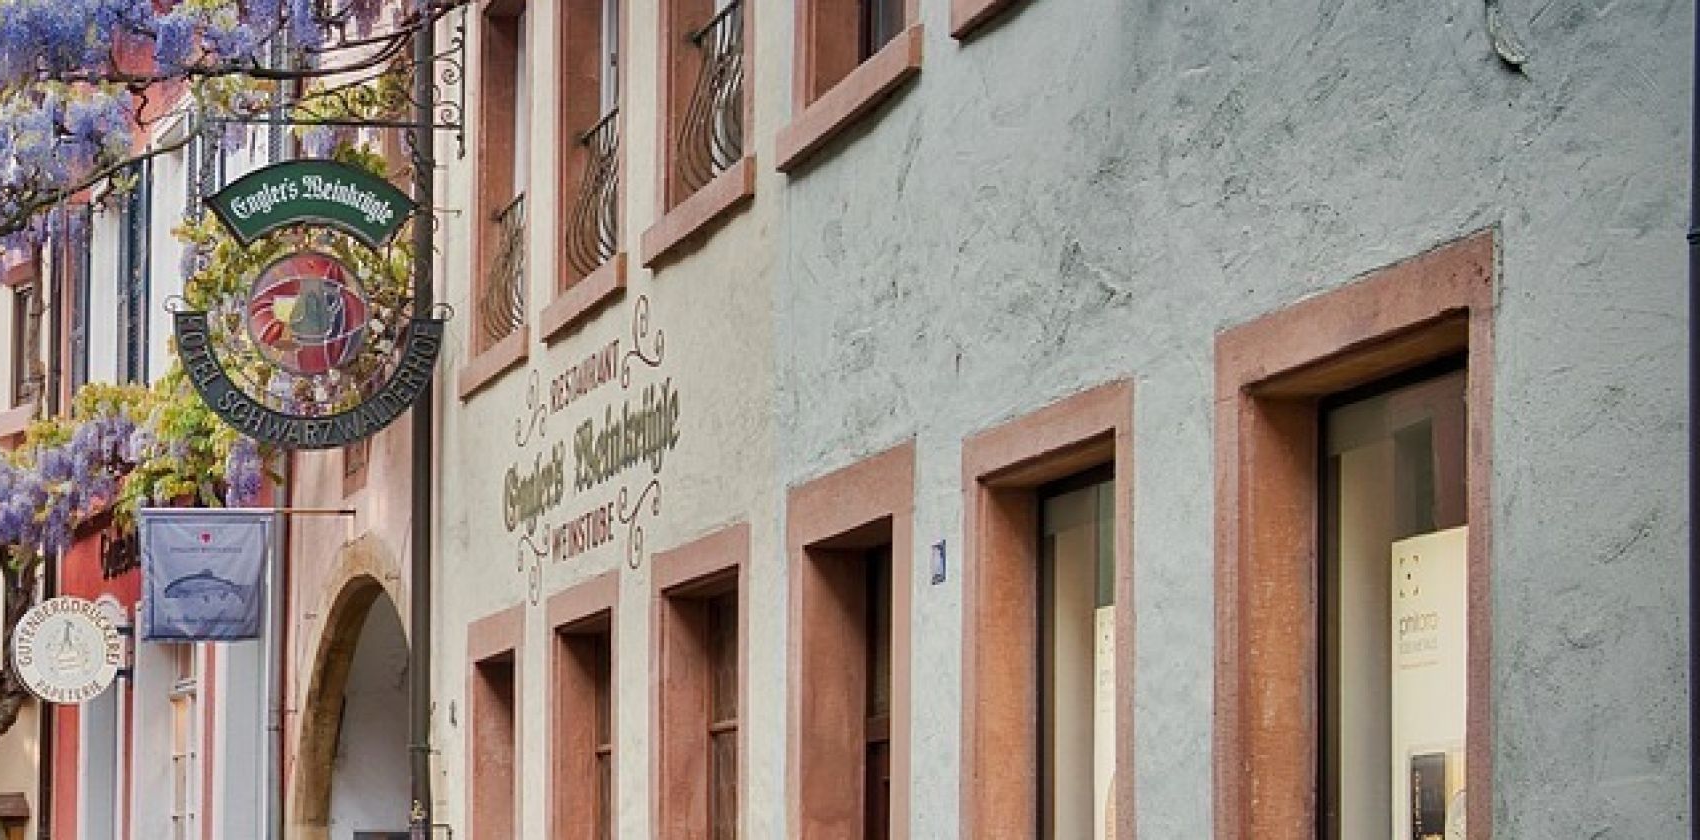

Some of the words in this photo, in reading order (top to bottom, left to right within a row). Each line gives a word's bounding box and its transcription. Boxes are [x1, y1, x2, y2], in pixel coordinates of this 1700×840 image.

[230, 177, 299, 219] Engler's
[178, 316, 221, 391] HOTEL
[550, 338, 620, 415] RESTAURANT
[552, 501, 615, 565] WEINSTUBE
[35, 680, 102, 700] PAPETERIE
